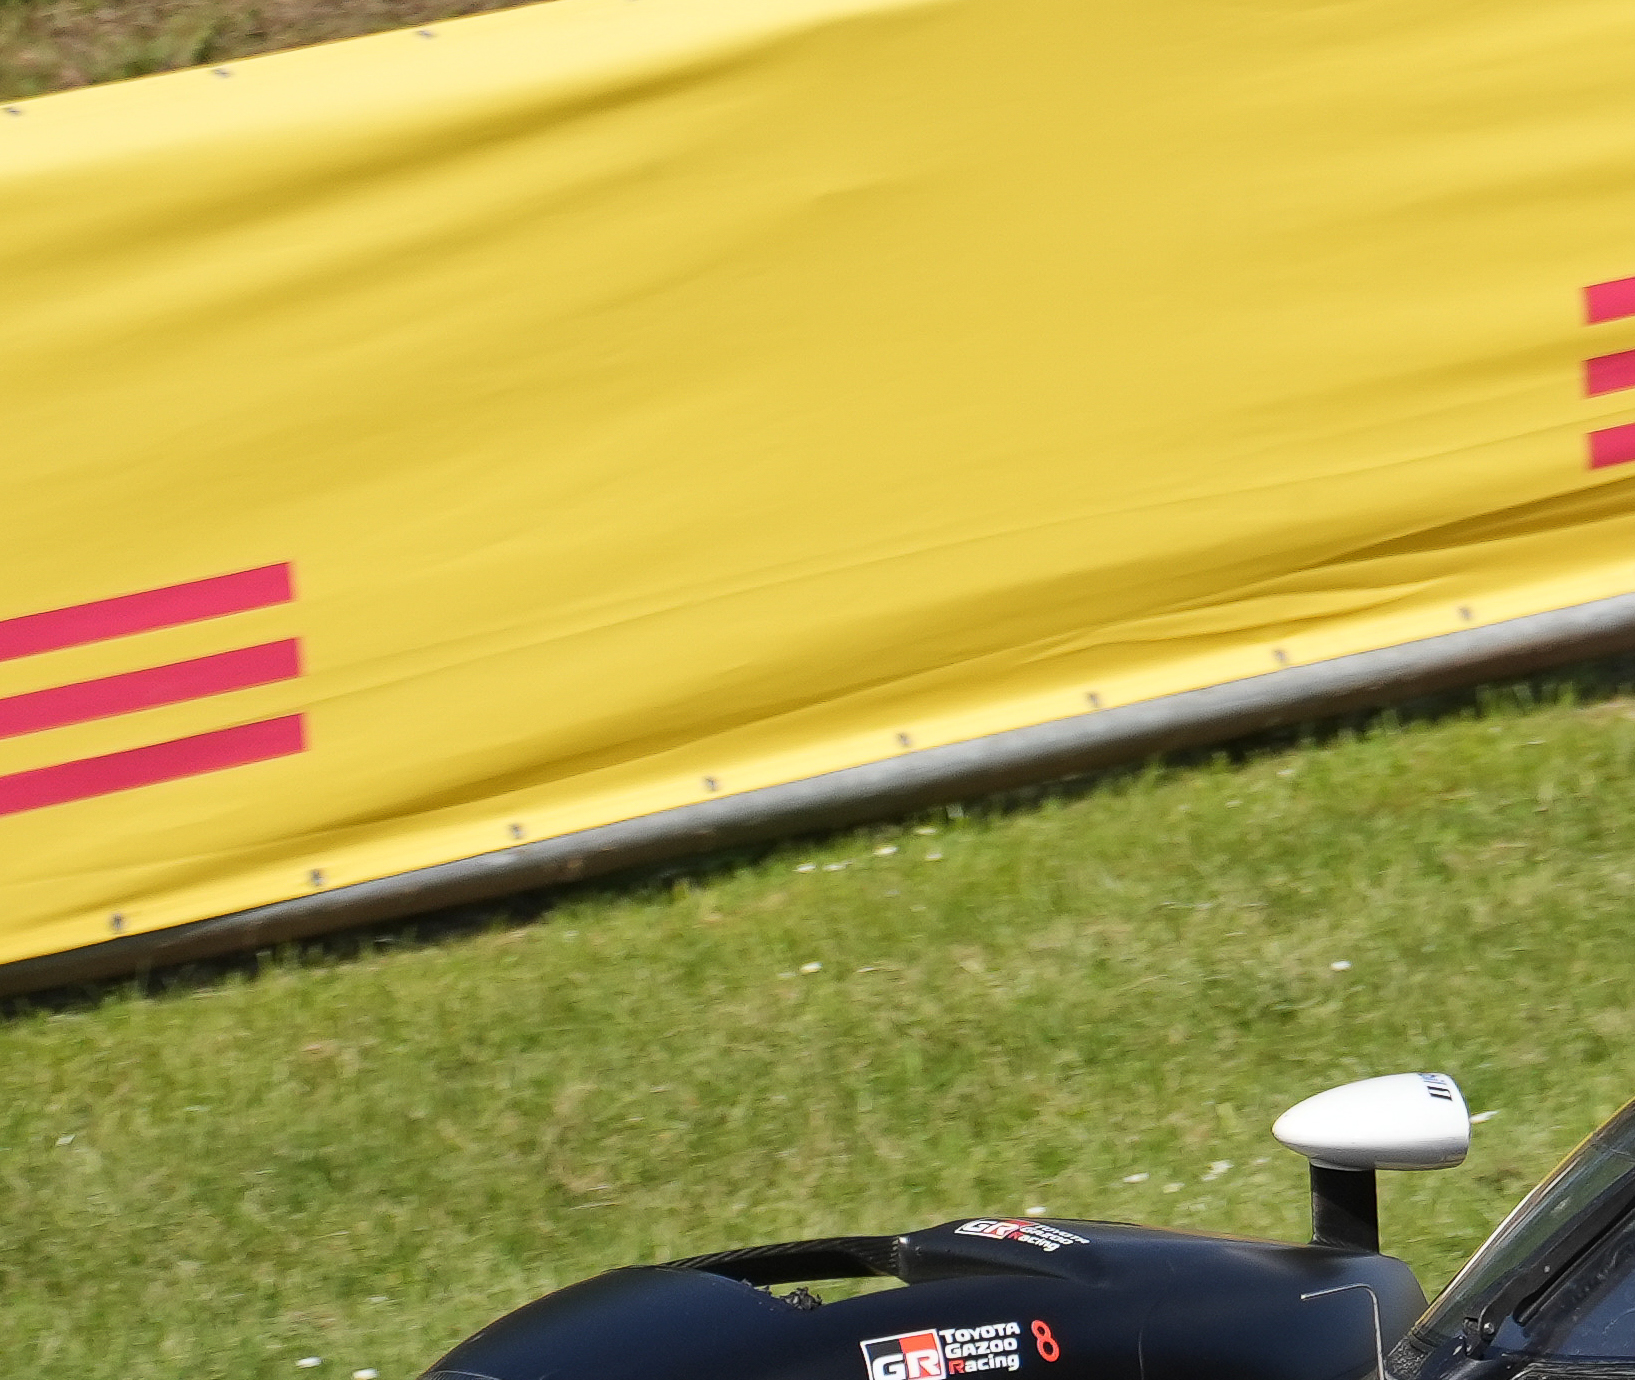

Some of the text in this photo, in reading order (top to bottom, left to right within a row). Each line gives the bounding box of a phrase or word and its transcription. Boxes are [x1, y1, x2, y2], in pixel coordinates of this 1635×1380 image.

[1007, 1231, 1061, 1252] Racing
[939, 1321, 1021, 1344] TOYOTA
[1030, 1319, 1060, 1363] 8
[944, 1337, 1018, 1359] GAZOO
[948, 1352, 1020, 1374] Racing
